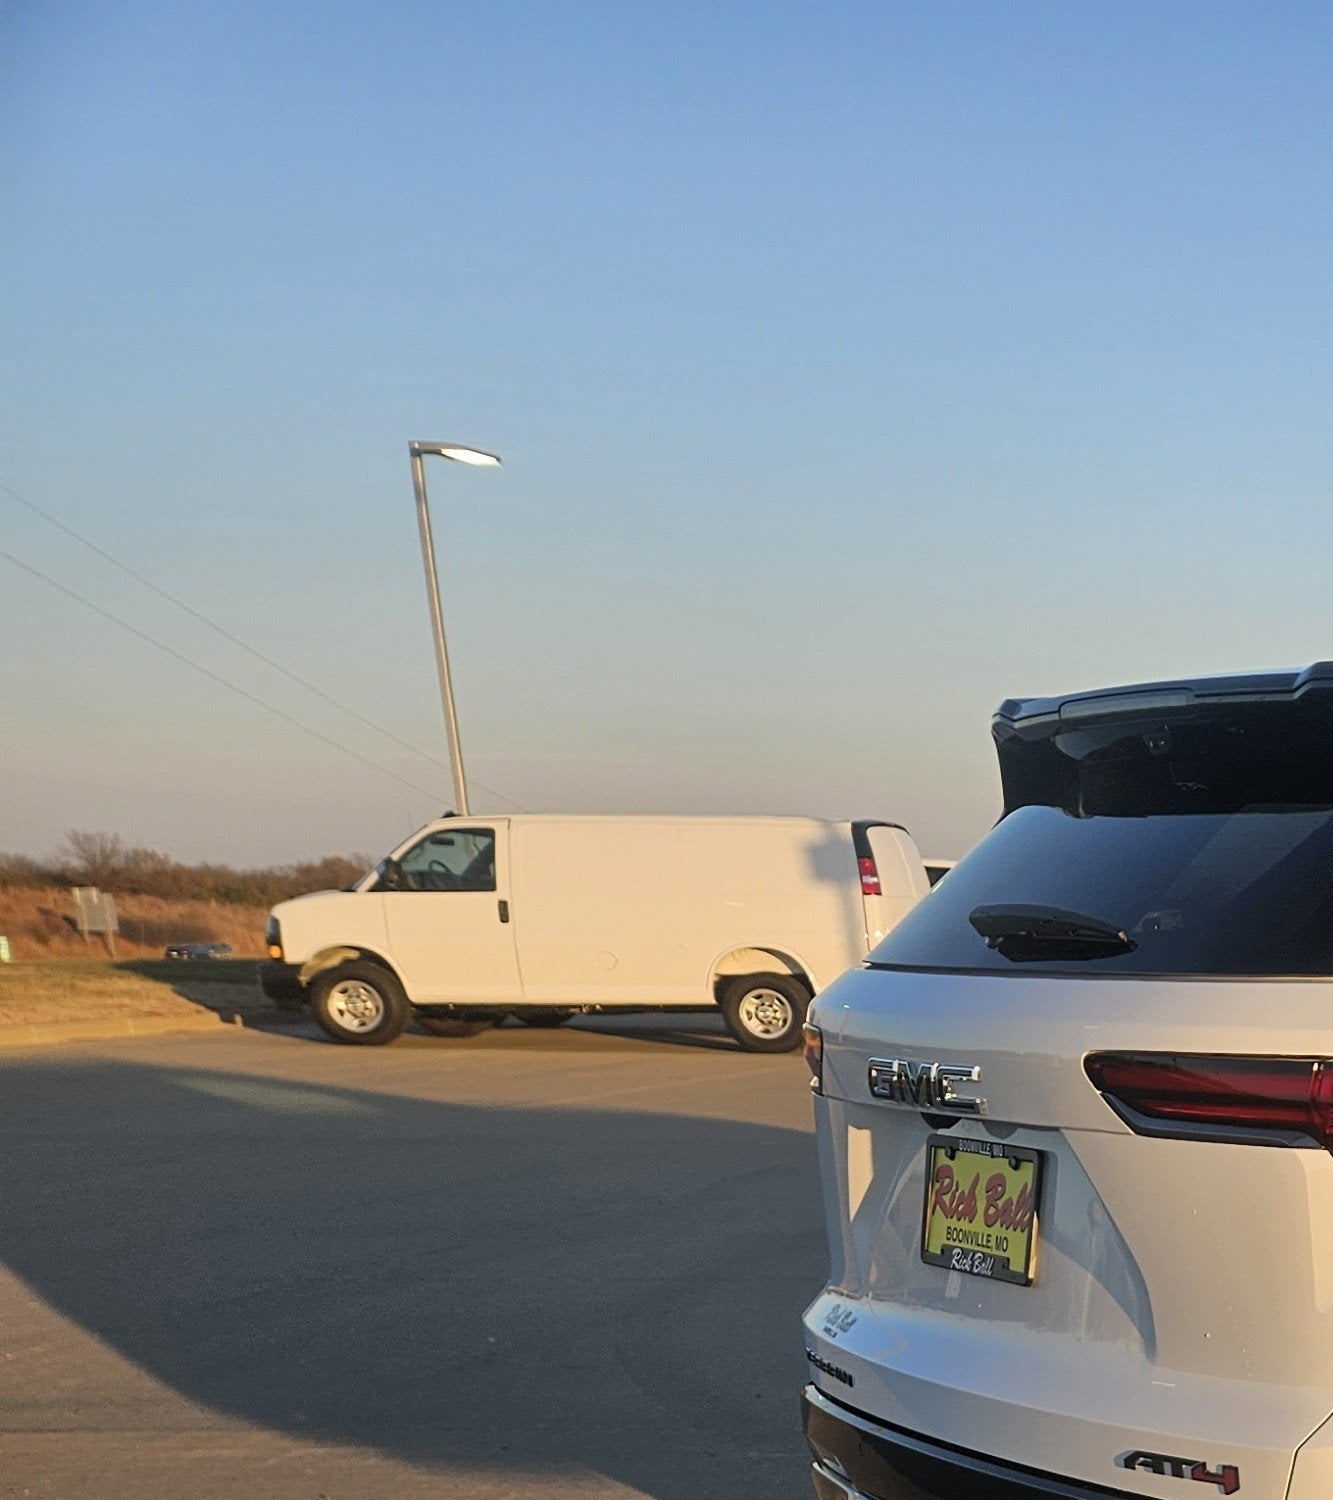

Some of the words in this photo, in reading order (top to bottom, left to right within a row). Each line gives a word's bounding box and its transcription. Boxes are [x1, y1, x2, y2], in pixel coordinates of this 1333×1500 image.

[868, 1056, 987, 1114] GMC
[931, 1164, 980, 1223] Rick
[983, 1172, 1033, 1233] Ball
[945, 1226, 993, 1252] BOONVILLE,
[994, 1234, 1009, 1253] MO
[950, 1248, 974, 1272] Rick
[972, 1252, 996, 1276] Ball
[1114, 1450, 1240, 1496] AT4
